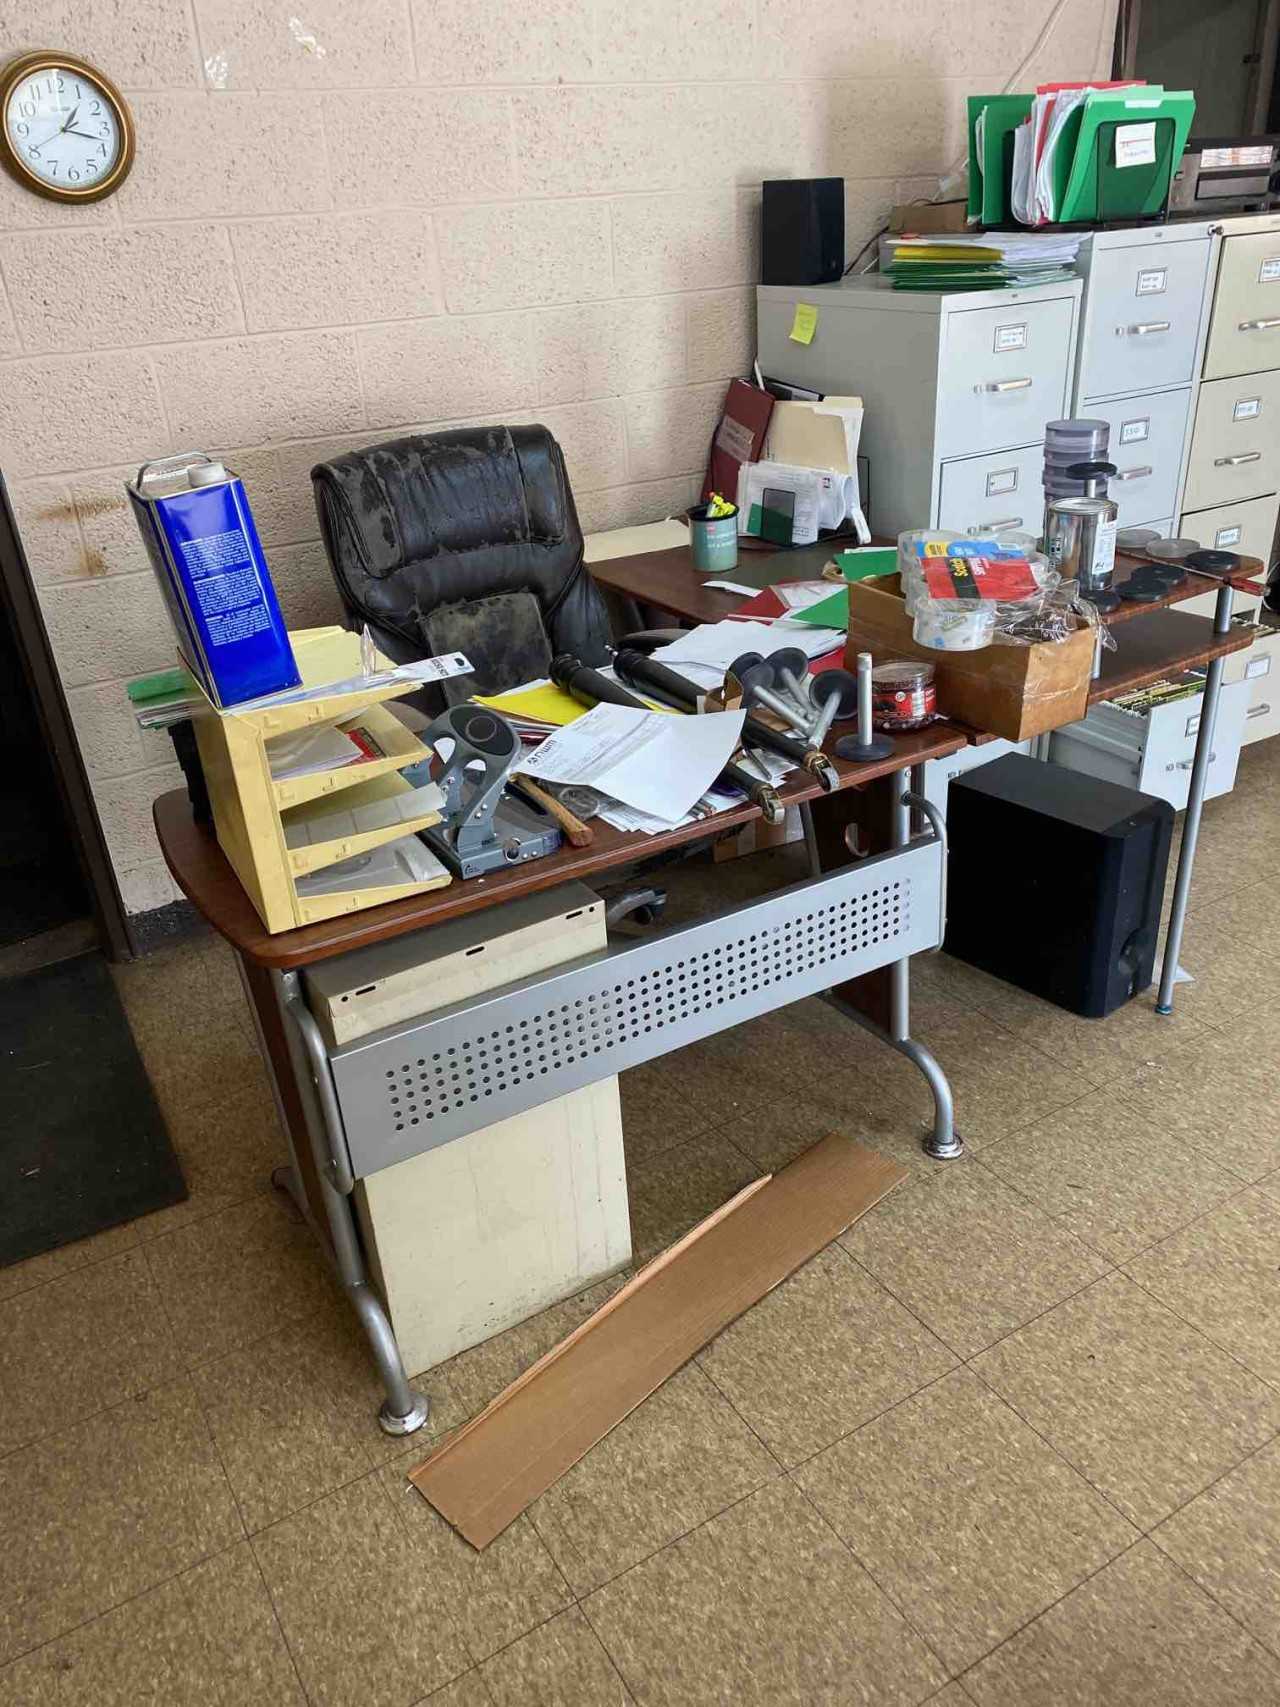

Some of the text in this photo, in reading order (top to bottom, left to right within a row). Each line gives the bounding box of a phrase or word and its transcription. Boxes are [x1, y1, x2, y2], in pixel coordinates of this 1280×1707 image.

[29, 84, 41, 101] 11
[47, 77, 65, 94] 12
[75, 84, 81, 99] 1
[18, 101, 36, 118] 10
[89, 100, 101, 116] 2
[16, 122, 30, 139] 9
[99, 121, 111, 137] 3
[28, 143, 41, 160] 8
[97, 142, 107, 158] 4
[47, 159, 59, 177] 7
[68, 165, 80, 181] 6
[85, 159, 98, 174] 5
